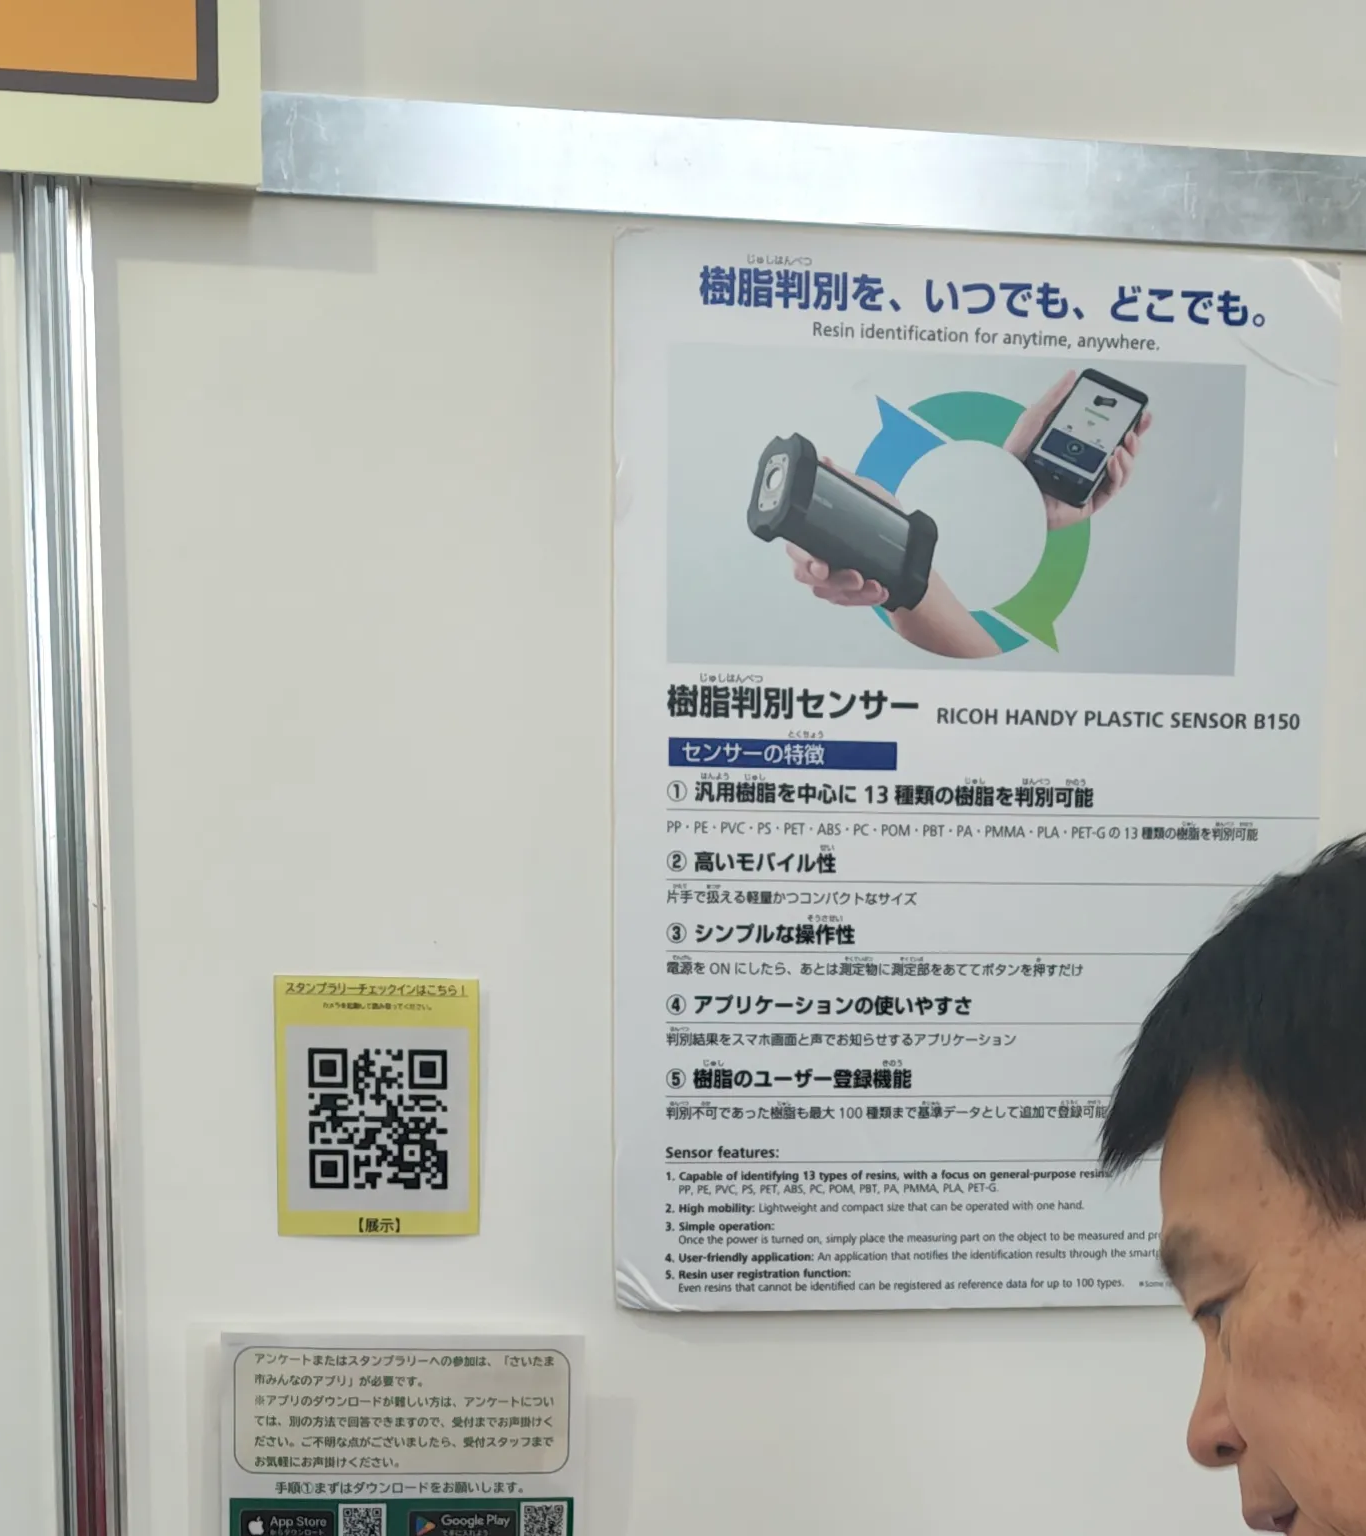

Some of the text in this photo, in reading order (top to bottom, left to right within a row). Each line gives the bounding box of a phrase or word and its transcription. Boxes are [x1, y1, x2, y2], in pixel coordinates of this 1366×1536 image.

[813, 322, 1159, 352] Resin identification for anytime, anywhere.
[937, 708, 1300, 730] RICOH HANDY PLASTIC SENSOR B150
[666, 1146, 778, 1158] Sensor features:
[666, 1203, 675, 1213] 2.
[679, 1203, 704, 1216] High
[708, 1203, 755, 1215] mobility:
[759, 1203, 817, 1215] Lightweight
[820, 1203, 838, 1212] and
[842, 1204, 883, 1213] compact
[908, 1202, 927, 1211] that
[951, 1202, 962, 1211] be
[966, 1201, 1009, 1212] operated
[1013, 1201, 1033, 1210] with
[1058, 1201, 1083, 1209] hand.
[270, 1516, 327, 1529] App Store
[441, 1514, 510, 1529] Google Play
